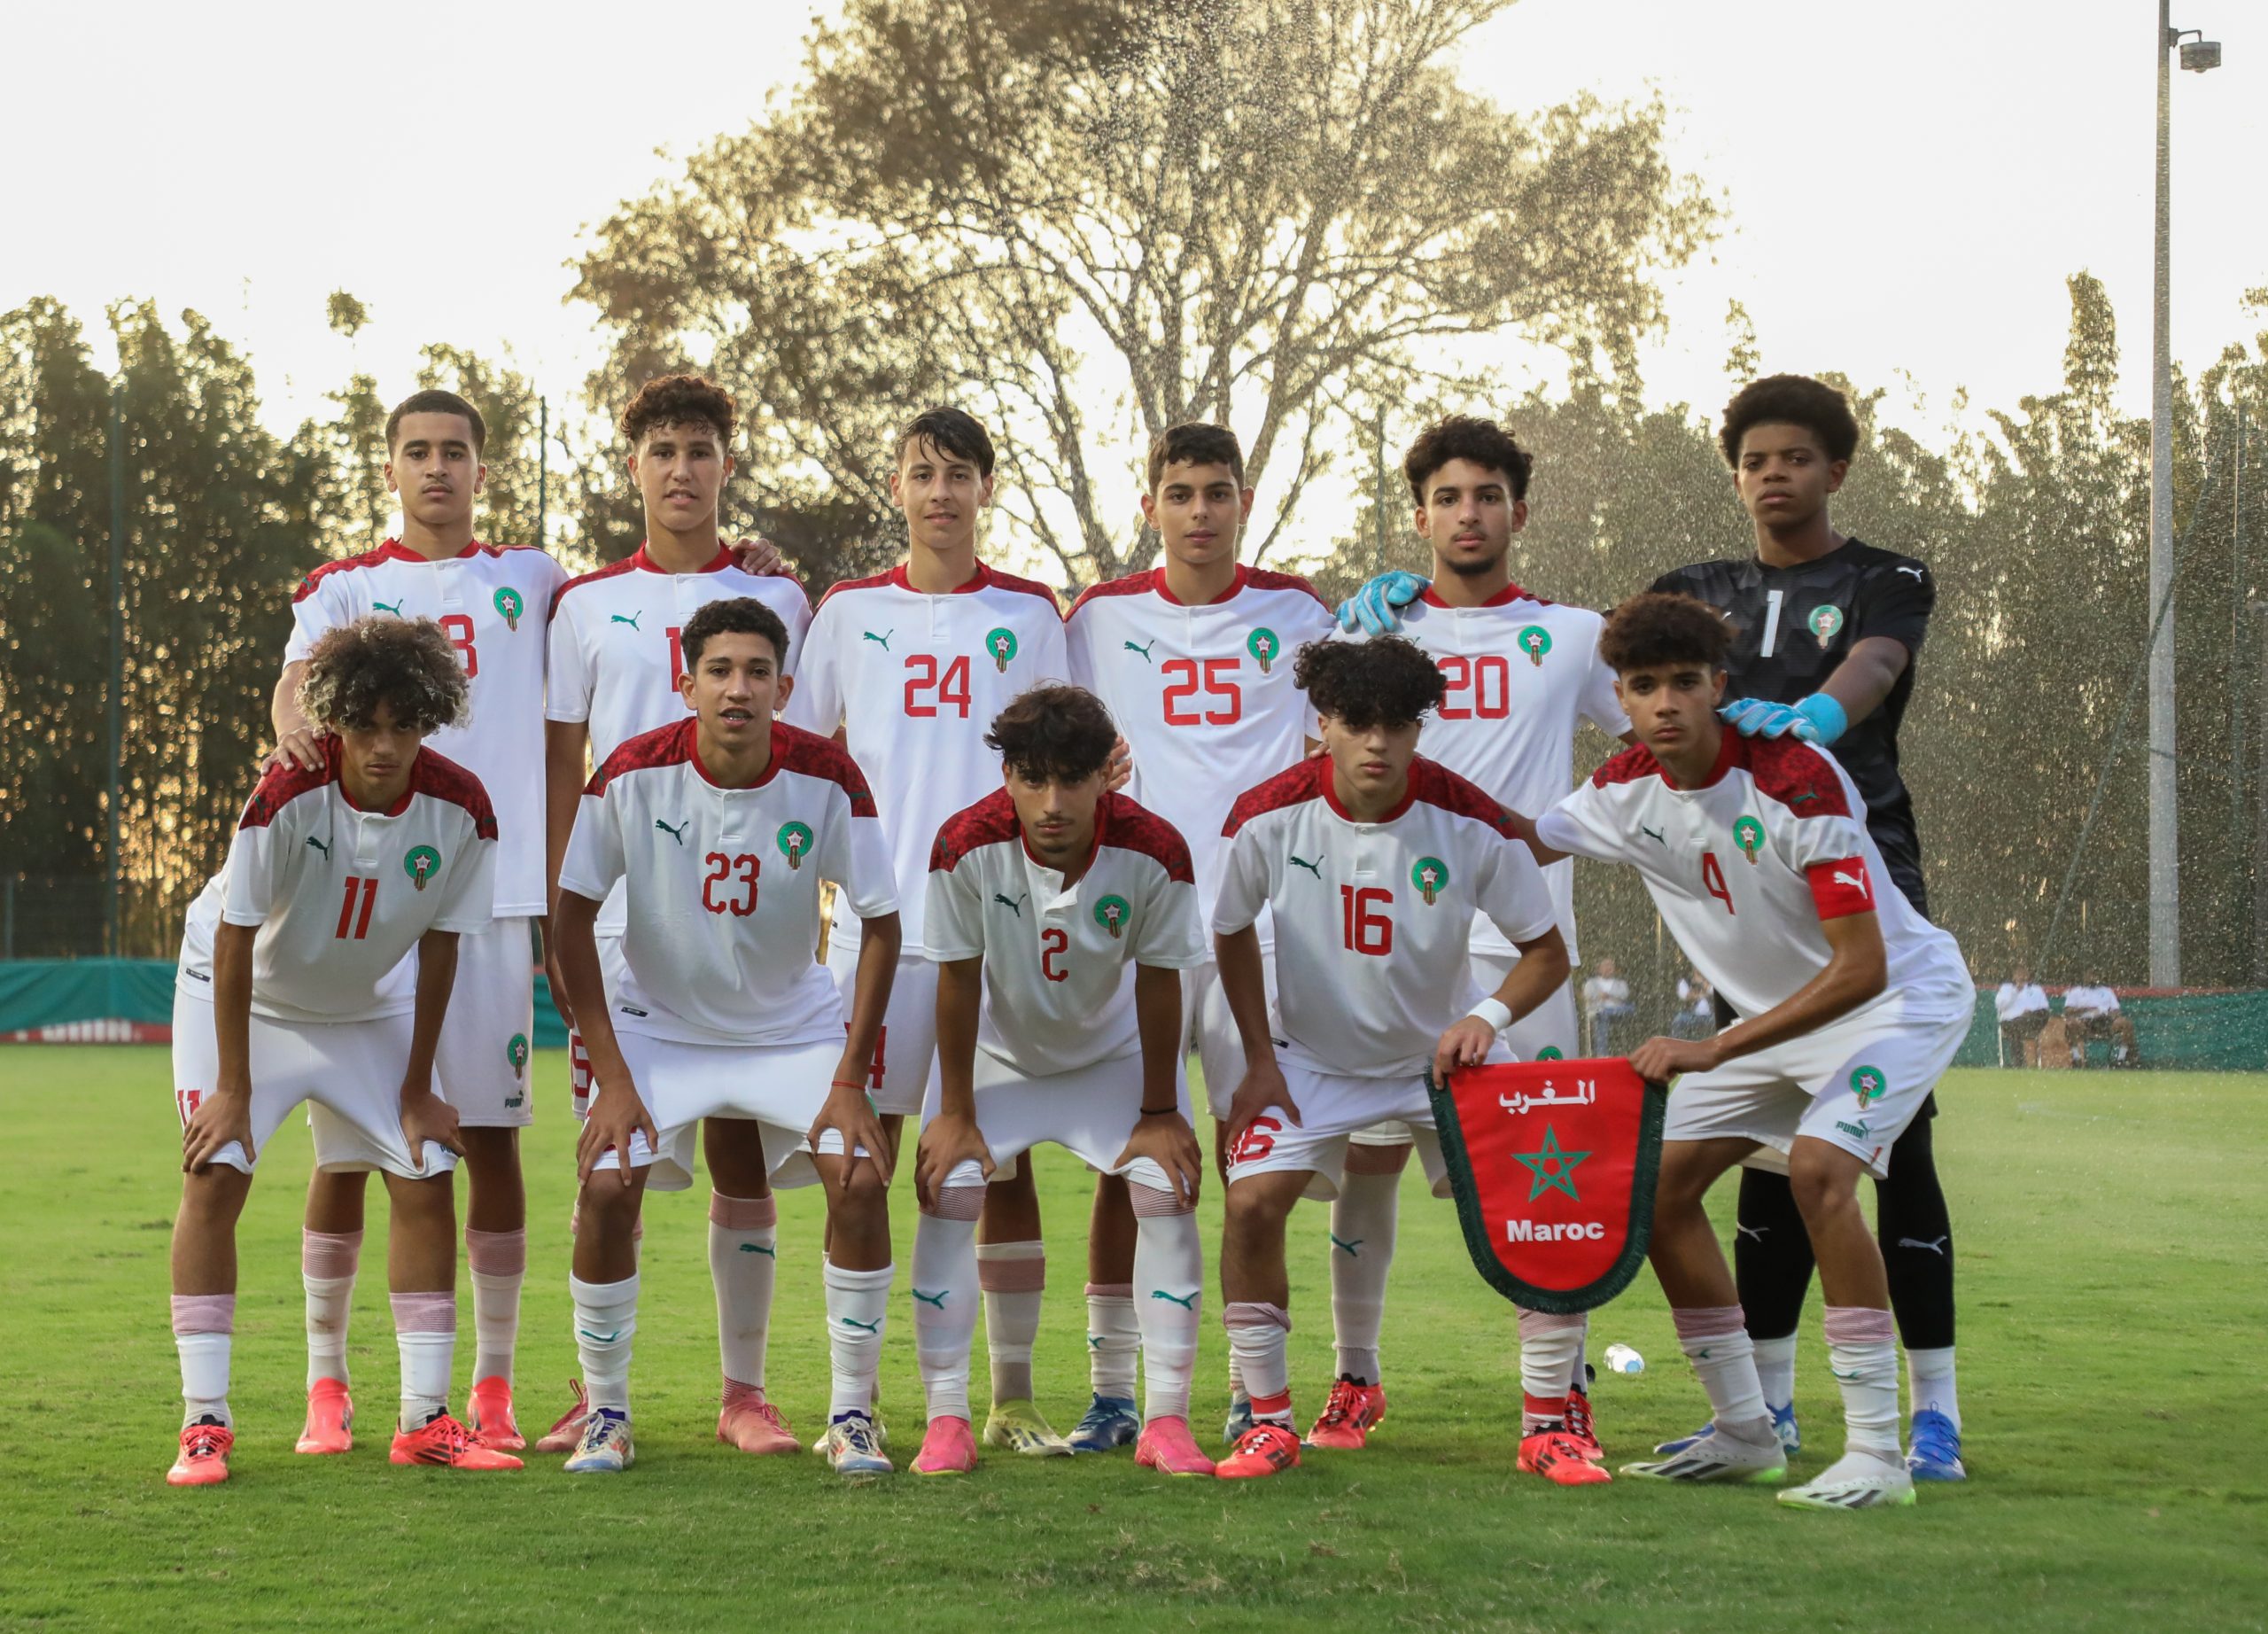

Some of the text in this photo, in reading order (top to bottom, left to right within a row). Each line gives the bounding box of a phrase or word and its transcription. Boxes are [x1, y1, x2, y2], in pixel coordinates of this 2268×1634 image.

[1761, 589, 1784, 657] 1
[905, 655, 971, 718] 24
[1161, 658, 1241, 726] 25
[1437, 657, 1510, 720] 20
[336, 876, 378, 939] 11
[703, 852, 760, 916] 23
[1703, 852, 1734, 914] 4
[1341, 885, 1393, 956] 16
[1041, 928, 1068, 982] 2
[1499, 1079, 1596, 1115] المغرب
[1506, 1219, 1605, 1242] Maroc
